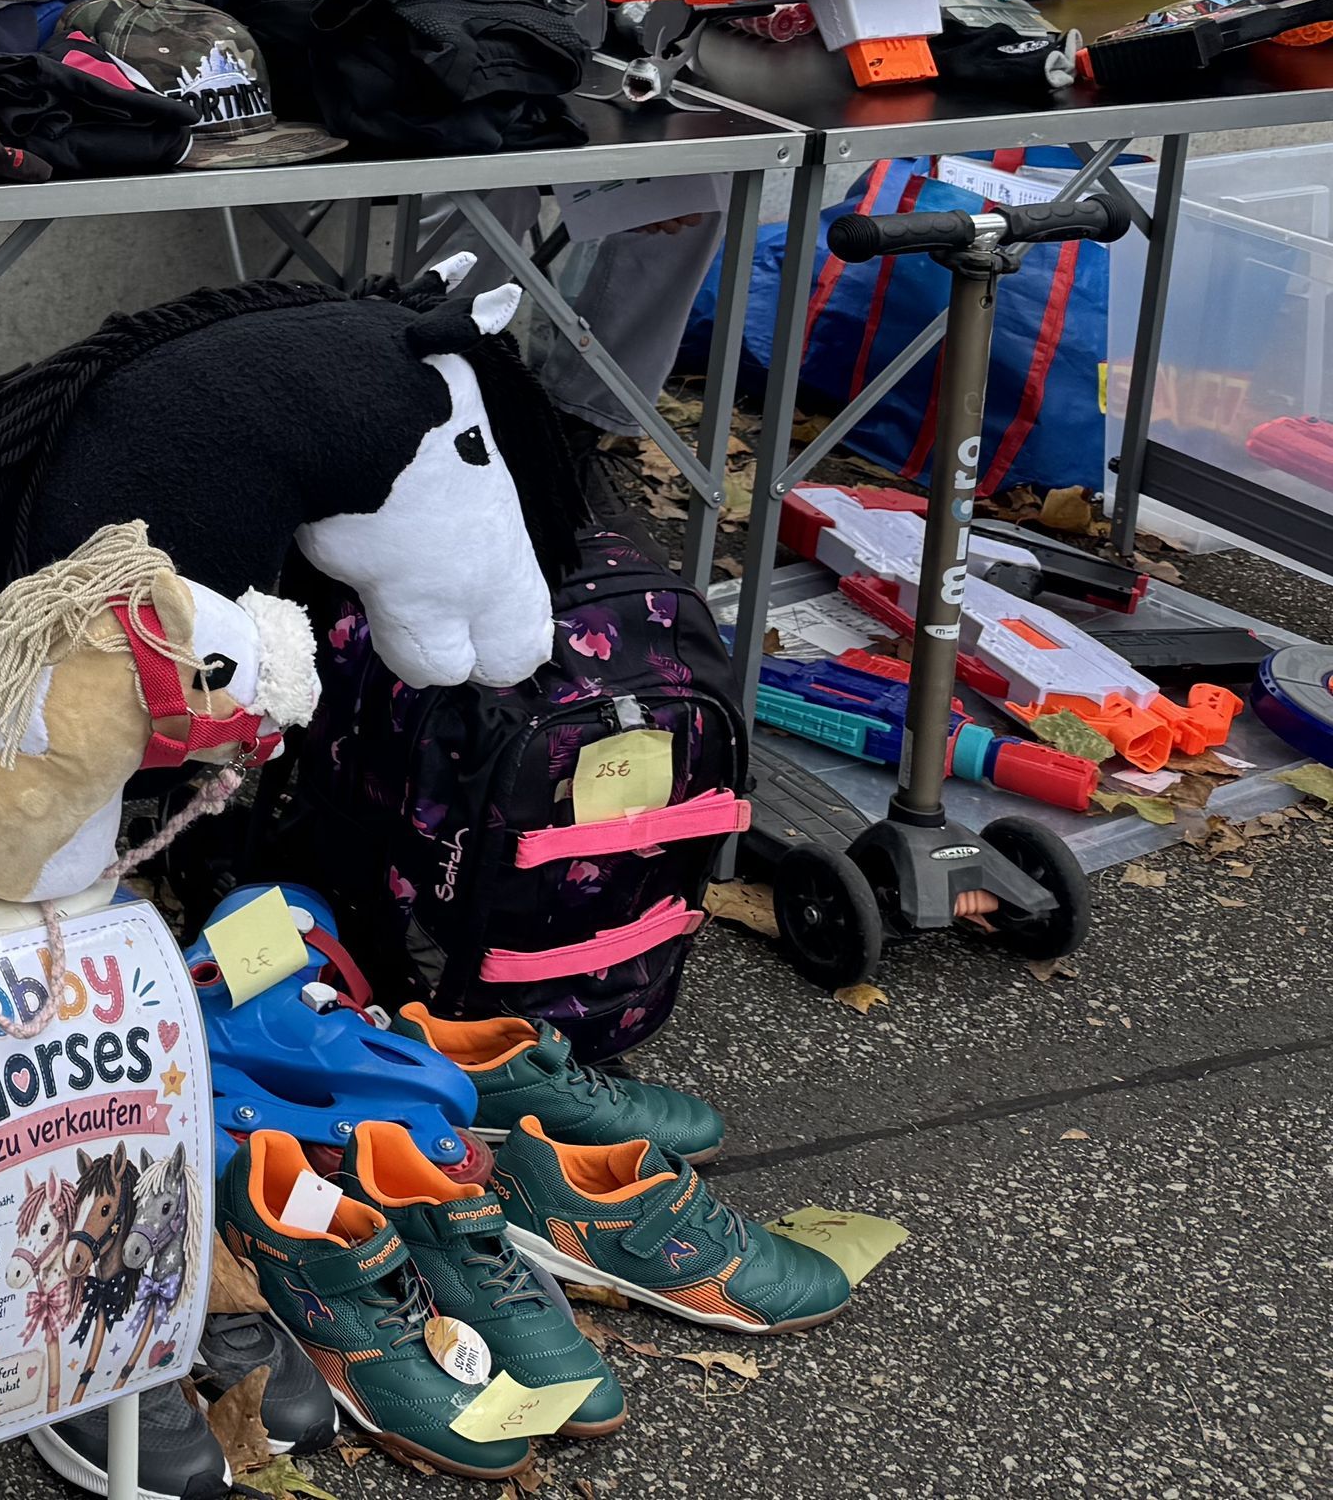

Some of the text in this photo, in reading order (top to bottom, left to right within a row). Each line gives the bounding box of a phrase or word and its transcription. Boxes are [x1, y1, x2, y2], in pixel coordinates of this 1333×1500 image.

[595, 759, 632, 779] 25€
[239, 946, 275, 976] 2€
[26, 1097, 142, 1148] verkaufen
[453, 1339, 468, 1371] SCHUL-
[463, 1346, 480, 1376] SPORT
